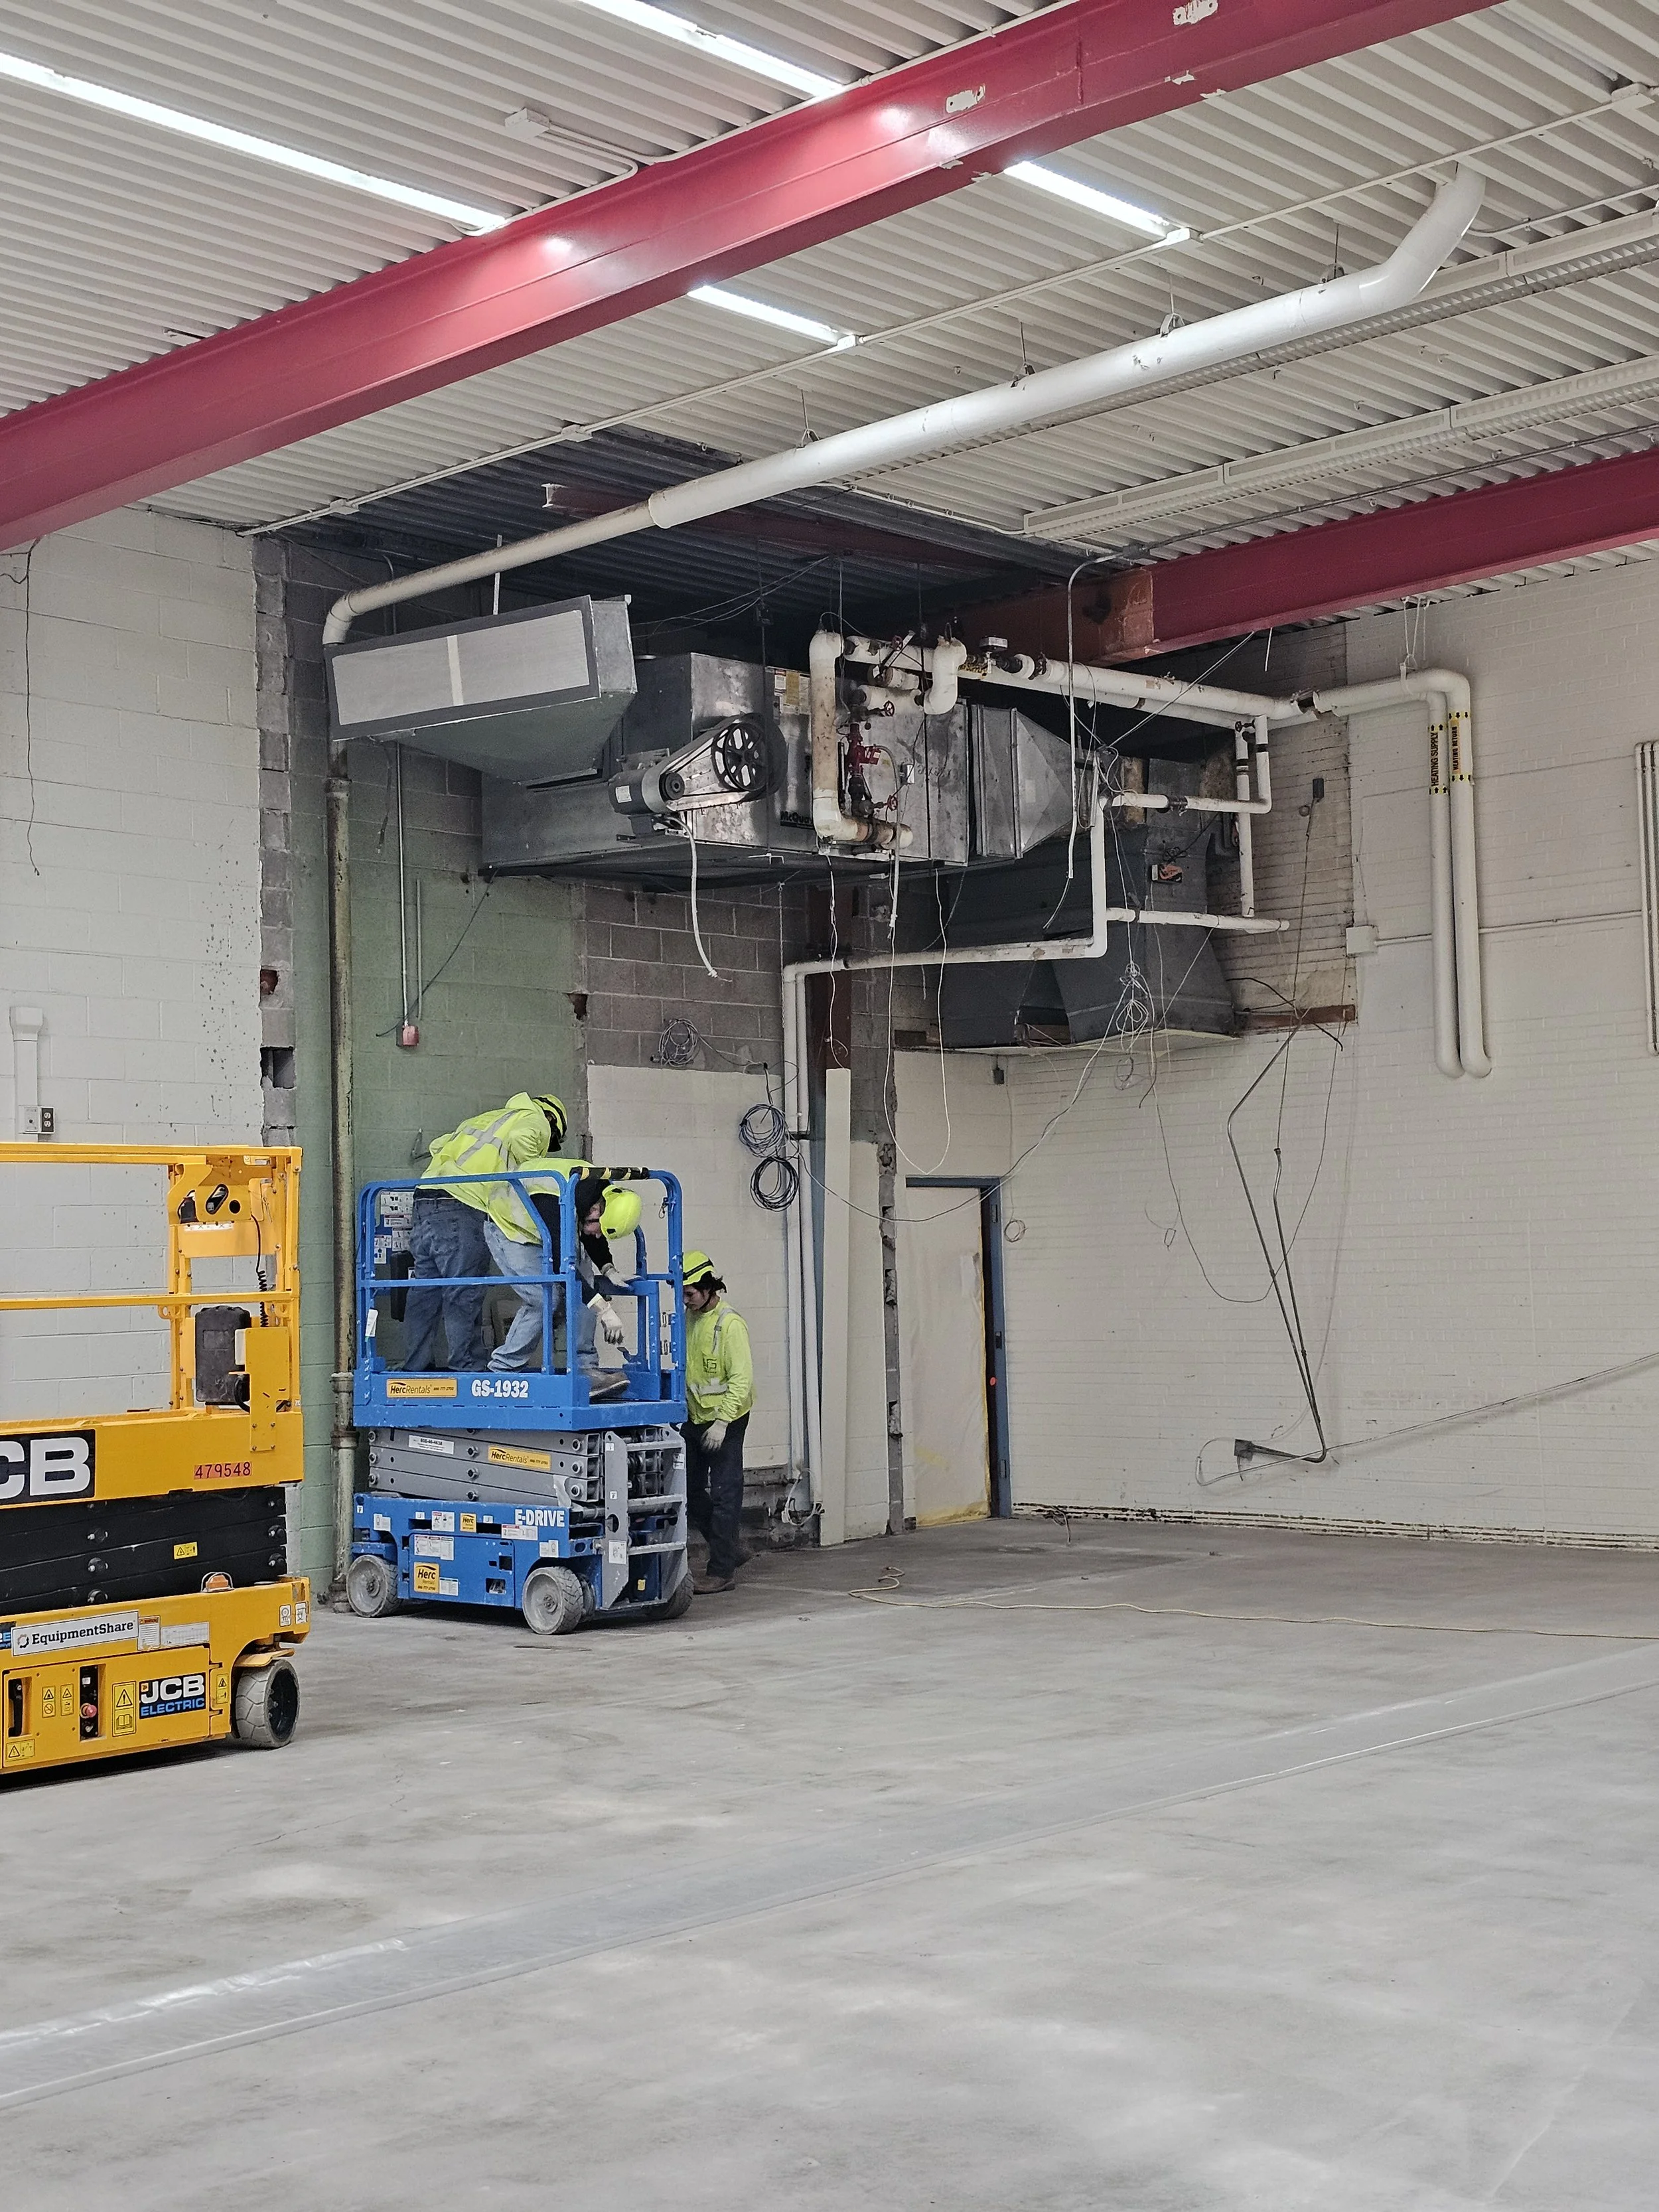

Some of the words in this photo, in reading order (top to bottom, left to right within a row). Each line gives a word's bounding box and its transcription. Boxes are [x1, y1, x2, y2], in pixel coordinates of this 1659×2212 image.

[1430, 732, 1439, 756] SUPPLY
[1430, 757, 1439, 786] HEATING
[472, 1380, 529, 1398] GS-1932
[194, 1461, 251, 1479] 479548
[514, 1509, 565, 1527] E-DRIVE
[417, 1568, 436, 1580] Herc
[32, 1621, 133, 1645] EquipmentShare
[141, 1674, 204, 1704] JCB
[141, 1698, 205, 1717] ELECTRIC
